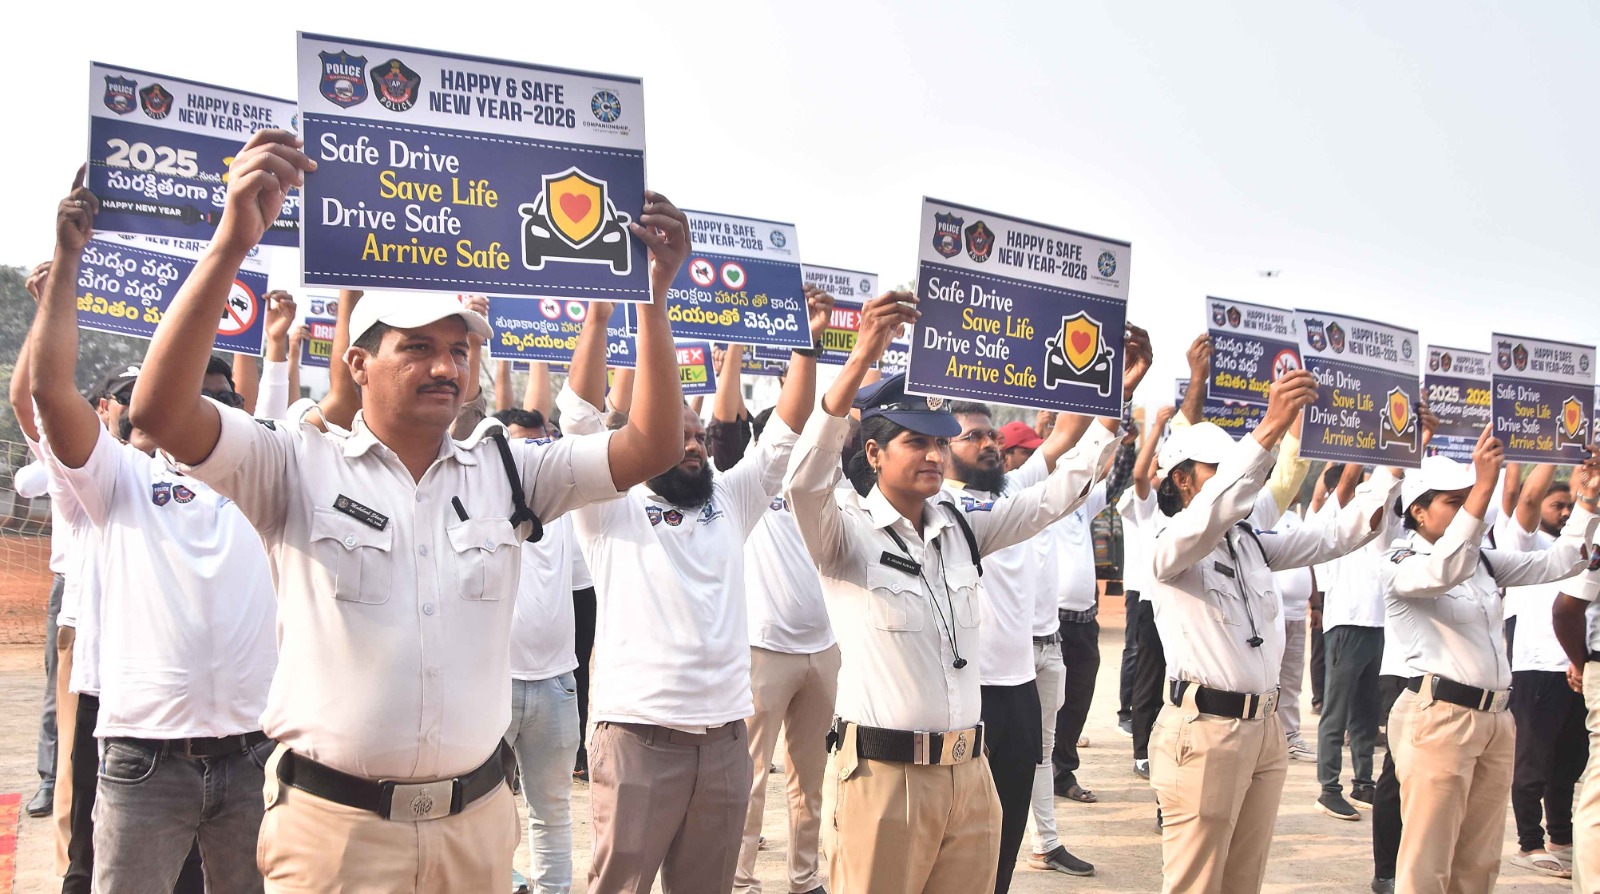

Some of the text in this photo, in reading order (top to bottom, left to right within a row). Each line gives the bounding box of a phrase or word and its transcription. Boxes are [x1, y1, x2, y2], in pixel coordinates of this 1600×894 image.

[326, 63, 361, 77] POLICE
[108, 83, 133, 95] POLICE
[440, 69, 564, 104] HAPPY & SAFE
[187, 93, 272, 122] HAPPY & SAFE
[380, 96, 413, 111] POLICE
[429, 92, 576, 128] NEW YEAR-2026
[178, 108, 207, 126] NEW
[105, 138, 199, 178] 2025
[320, 132, 460, 174] Safe Drive
[107, 170, 208, 200] సురక్షితంగా
[379, 170, 498, 208] Save Life
[102, 200, 182, 216] HAPPY NEW YEAR
[321, 197, 396, 230] Drive
[405, 204, 462, 236] Safe
[273, 220, 294, 228] NEW
[690, 219, 756, 238] HAPPY & SAFE
[938, 222, 960, 234] POLICE
[361, 232, 510, 270] Arrive Safe
[691, 232, 764, 250] EW YEAR-2026
[1006, 230, 1082, 261] HAPPY & SAFE
[82, 247, 179, 287] మద్యం వద్దు
[968, 250, 988, 262] POLICE
[998, 246, 1088, 281] NEW YEAR-2026
[78, 268, 162, 306] వేగం వద్దు
[806, 272, 850, 286] HAPPY & SAFE
[714, 290, 748, 306] హారన్
[752, 292, 768, 308] తో
[928, 276, 1013, 313] Safe Drive
[77, 292, 138, 320] జీవితం
[496, 316, 559, 334] శుభాకాంక్షలు
[668, 304, 798, 336] దయలతో చెప్పండి
[962, 308, 1034, 340] Save Life
[314, 324, 336, 340] DRI
[823, 332, 852, 348] RIVE
[924, 326, 1010, 360] Drive Safe
[1352, 326, 1373, 342] HAPPY
[1380, 332, 1394, 348] SAFE
[314, 342, 332, 355] THI
[882, 349, 908, 366] 202
[1349, 341, 1364, 355] NEW
[945, 355, 1037, 389] Arrive Safe
[1312, 366, 1361, 391] Safe Drive
[1332, 389, 1374, 412] Save Life
[1428, 384, 1460, 402] 2025
[1496, 384, 1540, 403] Safe Drive
[1310, 406, 1360, 429] Drive Safe
[1514, 402, 1551, 420] Save Life
[1498, 416, 1520, 433] Drive
[1522, 418, 1540, 434] Safe
[1322, 427, 1376, 450] Arrive Safe
[1510, 434, 1554, 451] Arrive Safe
